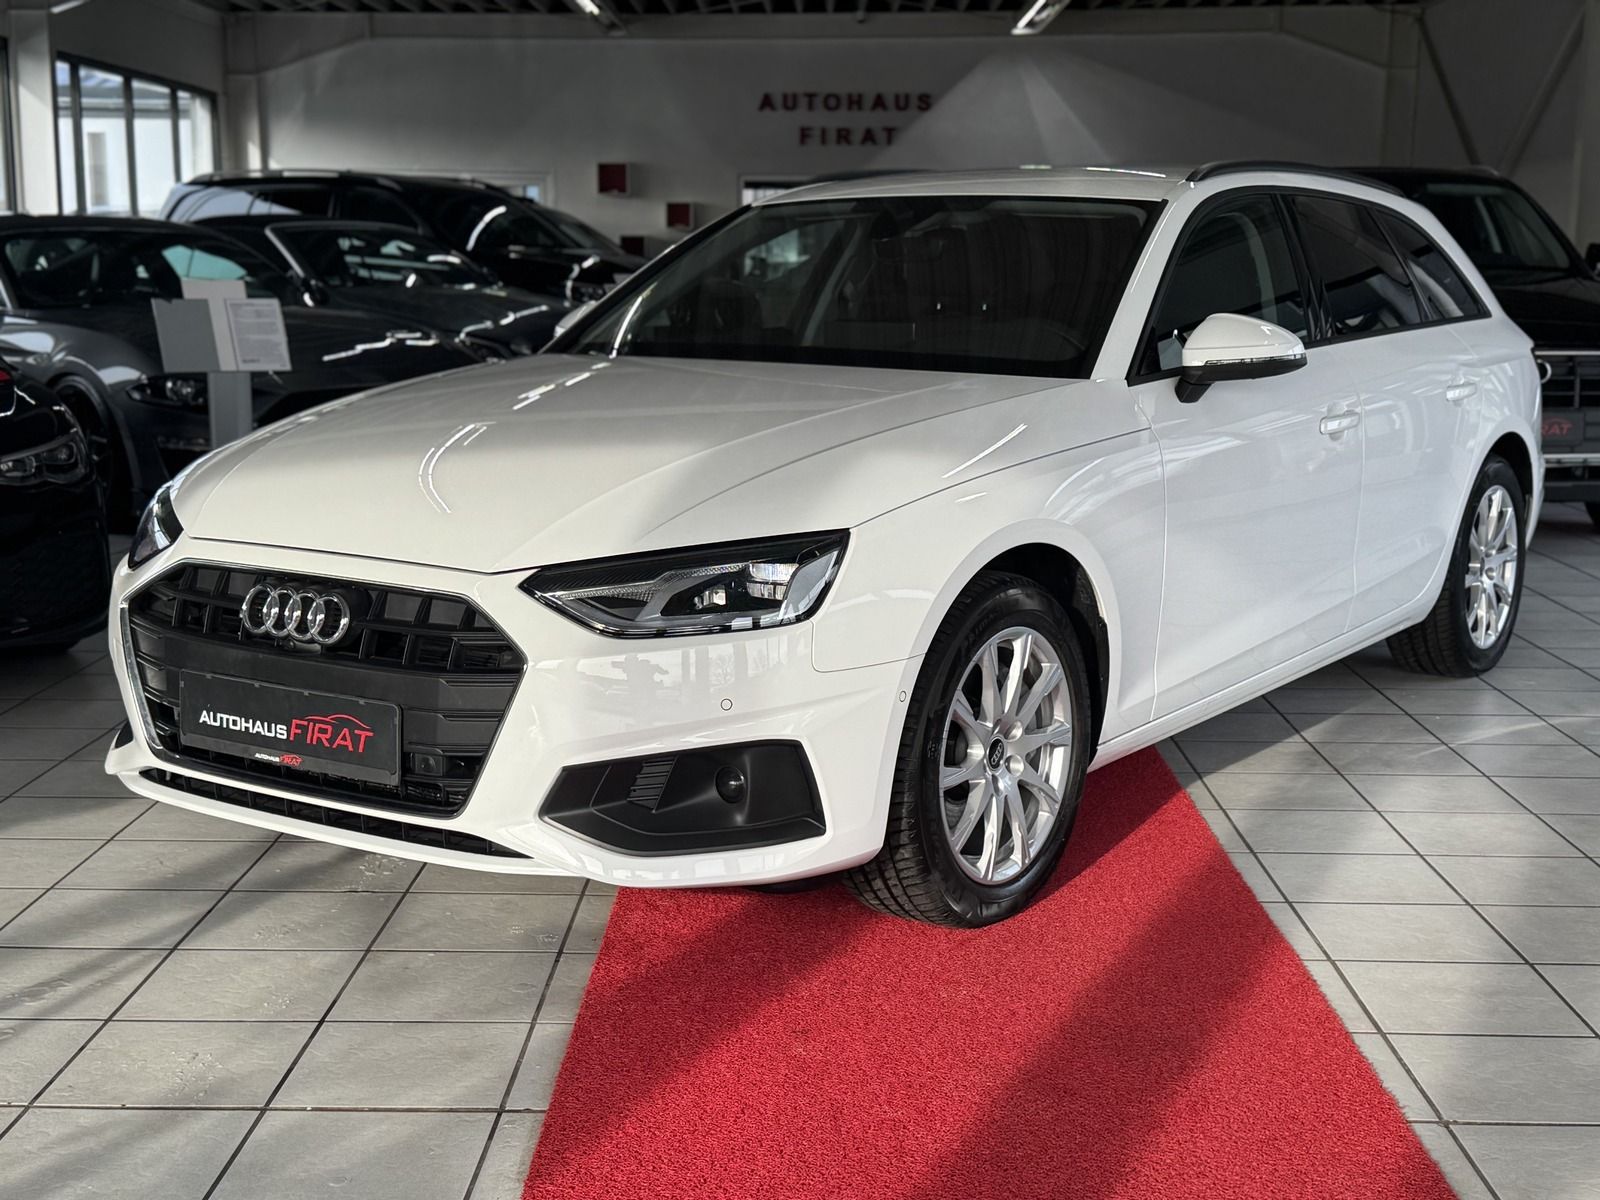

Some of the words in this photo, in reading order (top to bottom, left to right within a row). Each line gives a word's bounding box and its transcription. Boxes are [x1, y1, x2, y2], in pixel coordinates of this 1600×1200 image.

[758, 92, 933, 112] AUTOHAUS
[799, 126, 897, 146] FIRAT
[199, 709, 288, 740] AUTOHAUS
[289, 718, 375, 753] FIRAT
